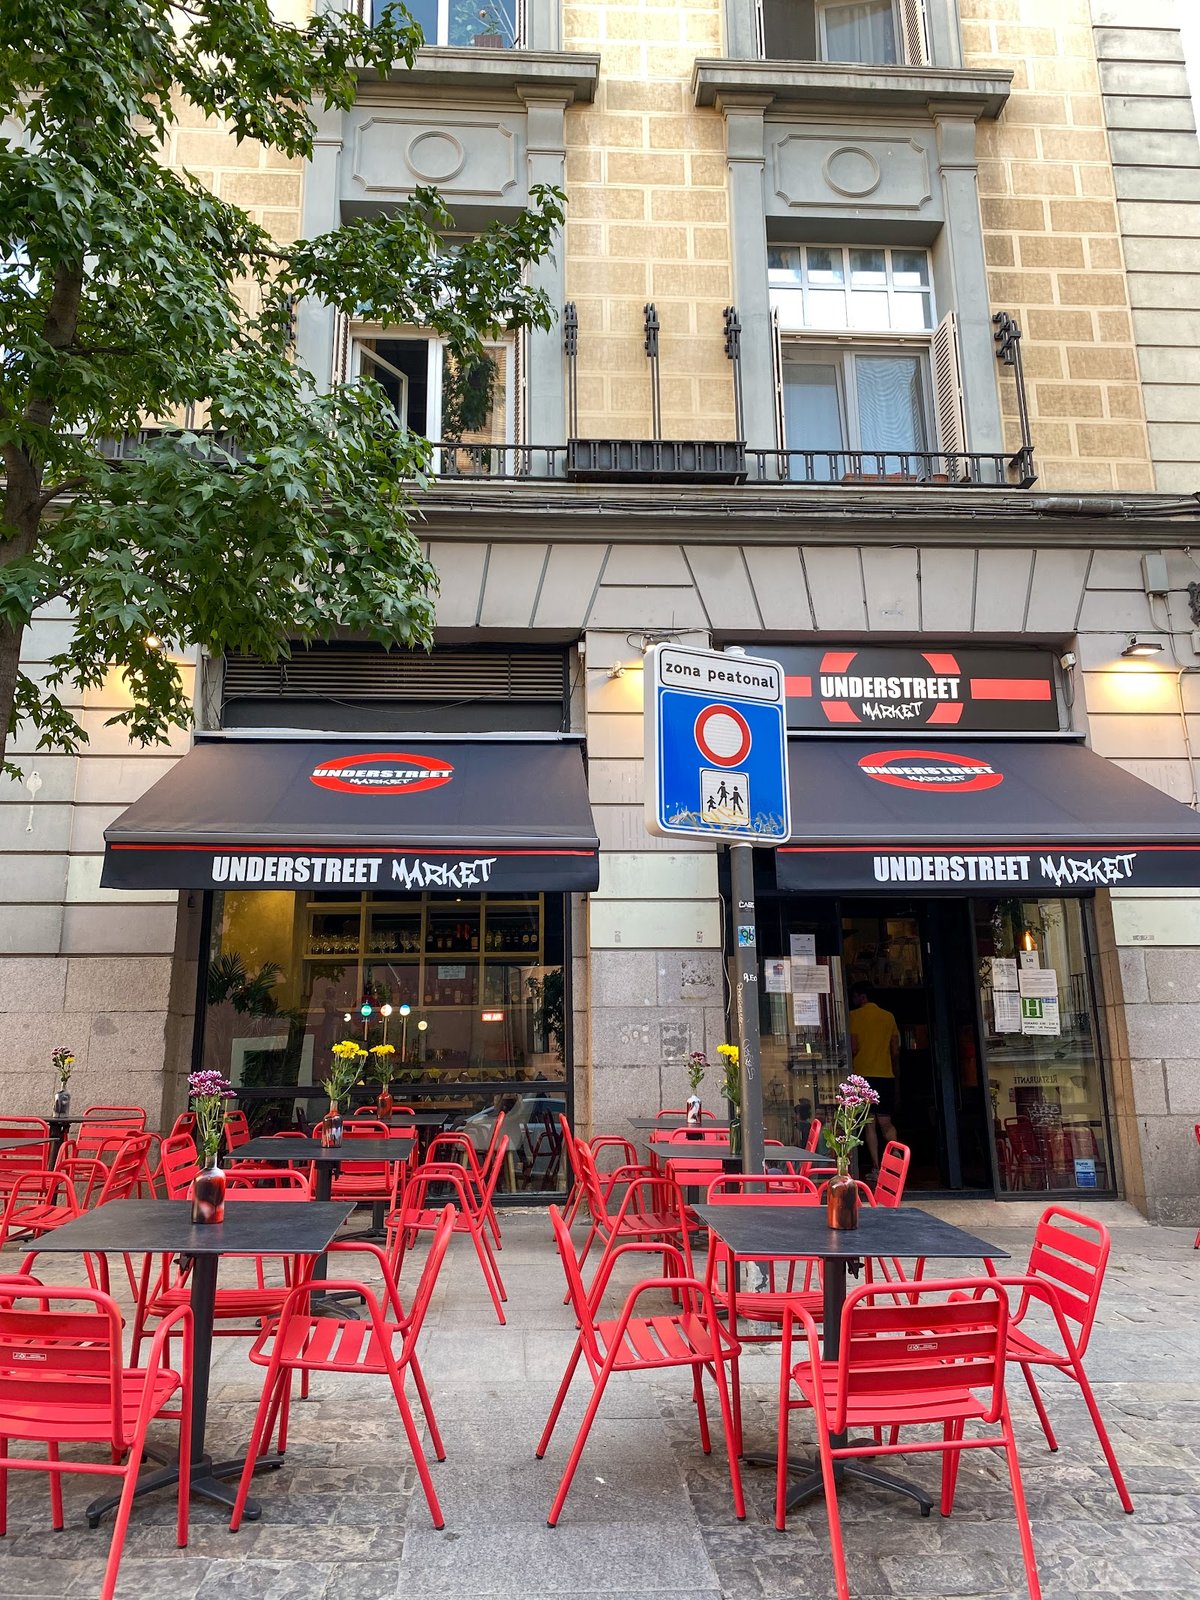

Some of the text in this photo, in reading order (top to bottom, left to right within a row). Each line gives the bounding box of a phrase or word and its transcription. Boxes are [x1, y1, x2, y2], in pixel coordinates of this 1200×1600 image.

[665, 662, 775, 688] zona peatonal
[820, 676, 960, 699] UNDERSTREET
[861, 701, 924, 721] MARKET
[312, 769, 453, 778] UNDERSTREET
[860, 766, 996, 775] UNDERSTREET
[211, 856, 497, 889] UNDERSTREET MARKET
[873, 852, 1137, 887] UNDERSTREET MARKET
[1023, 999, 1042, 1017] H
